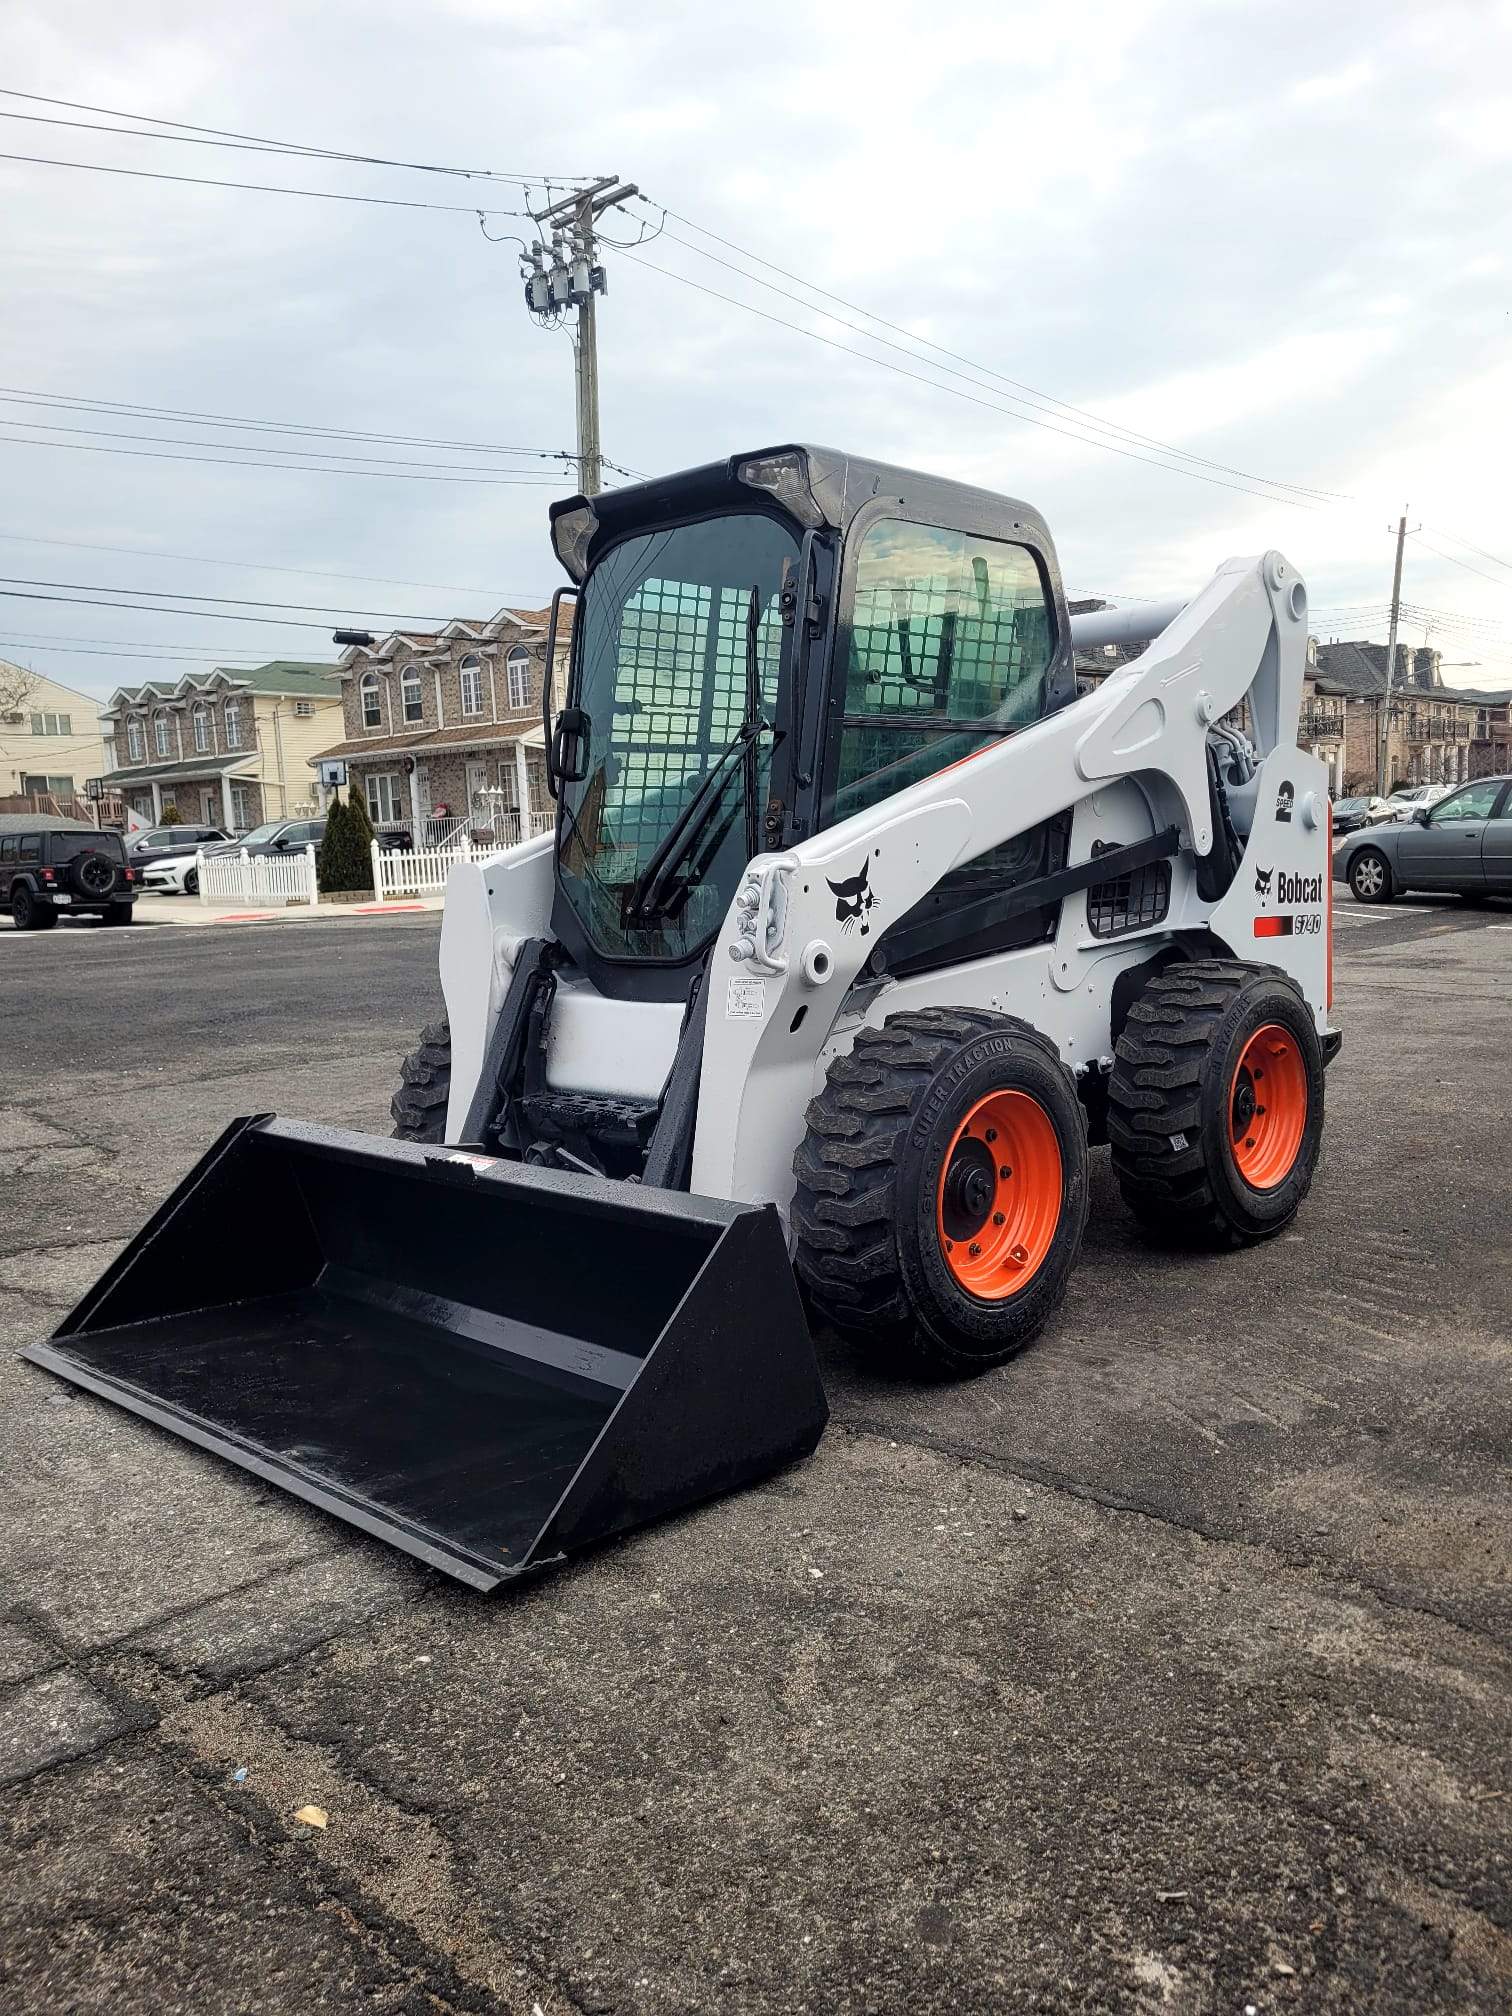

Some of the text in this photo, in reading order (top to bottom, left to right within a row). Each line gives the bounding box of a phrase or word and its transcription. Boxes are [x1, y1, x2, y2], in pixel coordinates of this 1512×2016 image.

[1275, 798, 1294, 809] SPEED
[1278, 872, 1323, 904] Bobcat
[1294, 914, 1322, 935] S740
[912, 1085, 948, 1149] SUPER
[945, 1038, 1013, 1085] TRACTION
